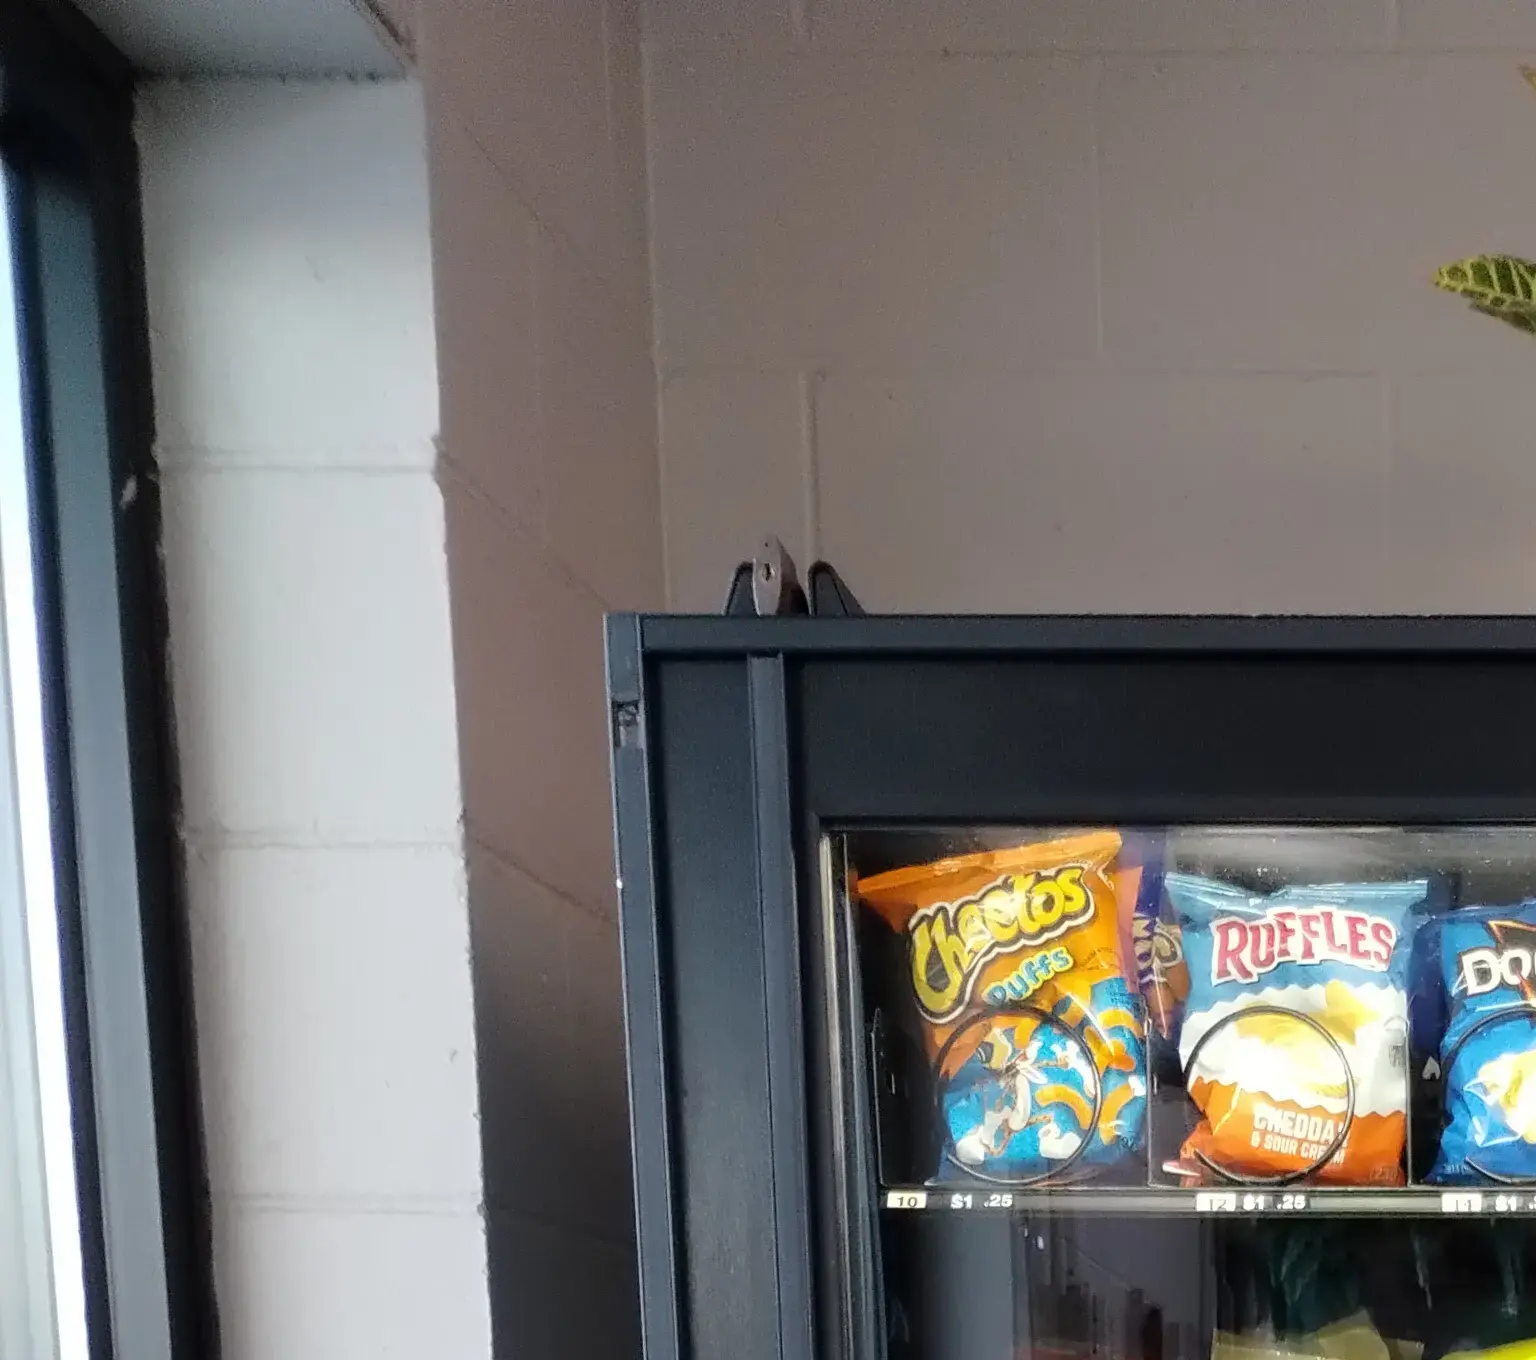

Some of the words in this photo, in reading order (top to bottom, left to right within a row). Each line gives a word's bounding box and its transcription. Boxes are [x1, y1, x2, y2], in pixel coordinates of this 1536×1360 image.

[912, 866, 1090, 1016] Cheetos
[1216, 908, 1396, 980] RUFFLES
[1263, 1136, 1297, 1158] SOUR
[896, 1195, 918, 1208] 10
